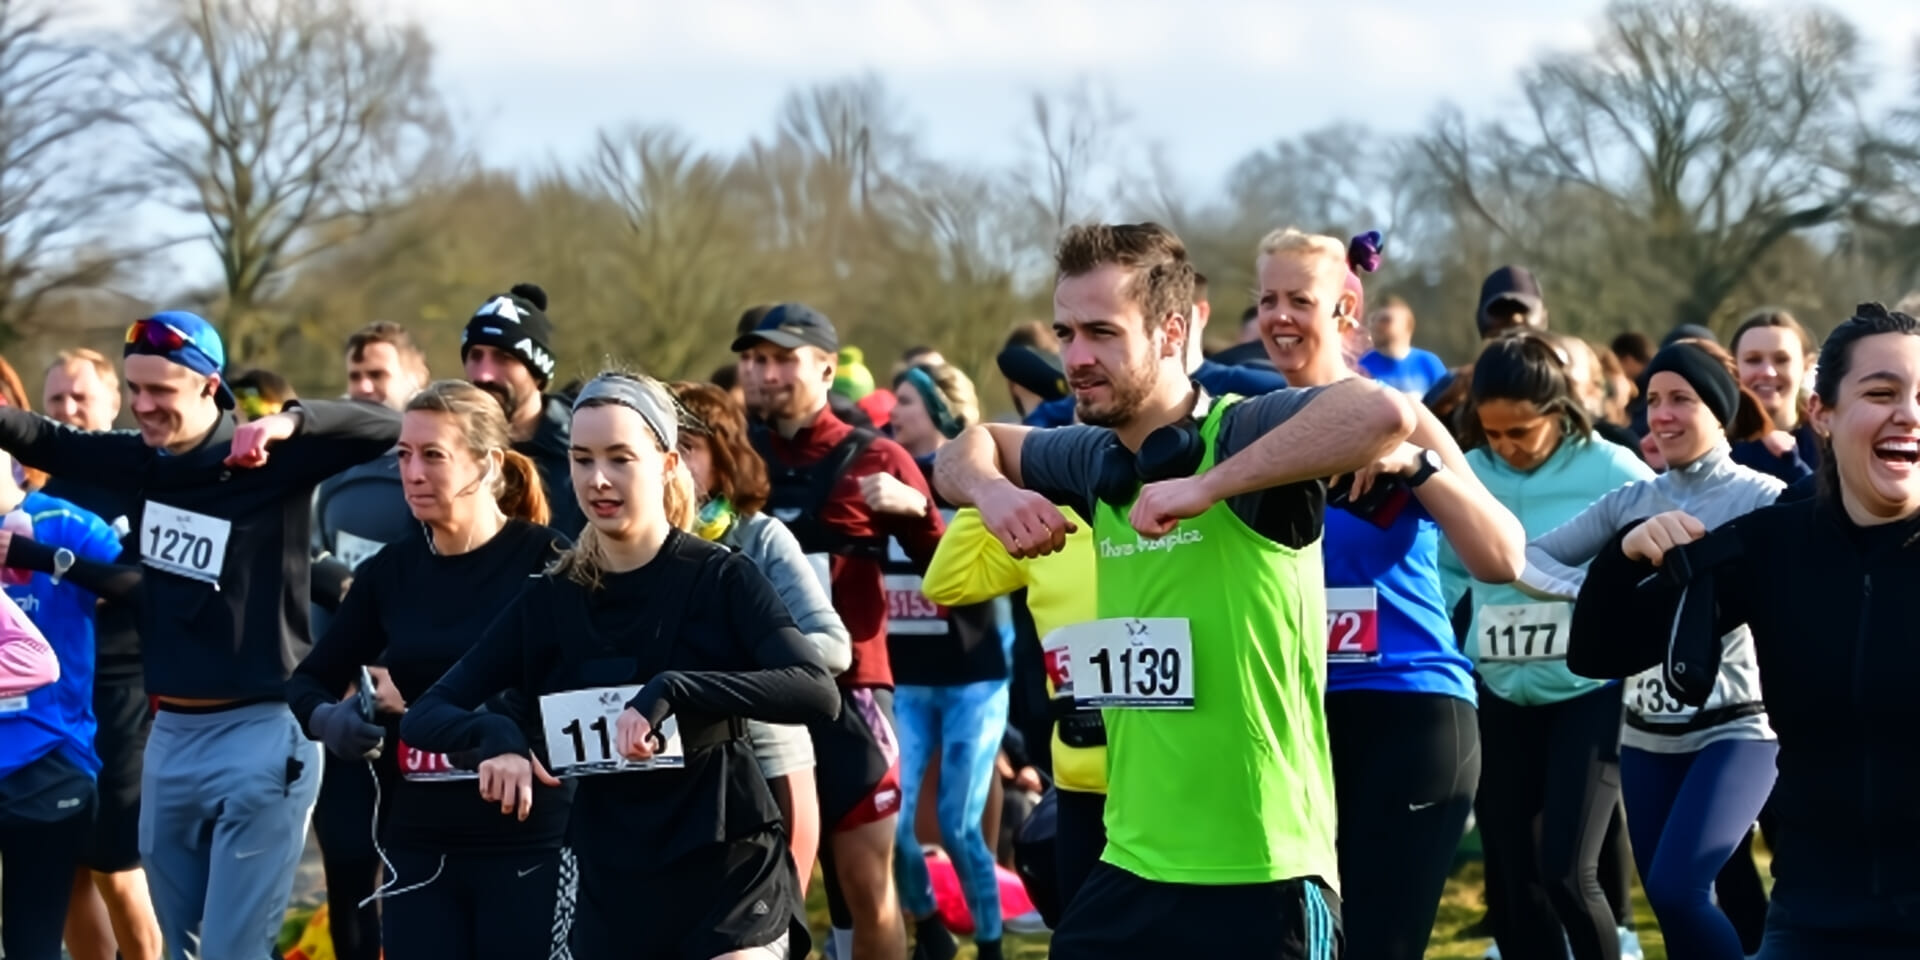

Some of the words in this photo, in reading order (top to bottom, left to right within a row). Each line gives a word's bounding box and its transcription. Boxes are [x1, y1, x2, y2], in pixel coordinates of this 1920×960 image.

[149, 525, 213, 569] 1270
[1486, 623, 1557, 656] 1177
[1089, 648, 1181, 696] 1139
